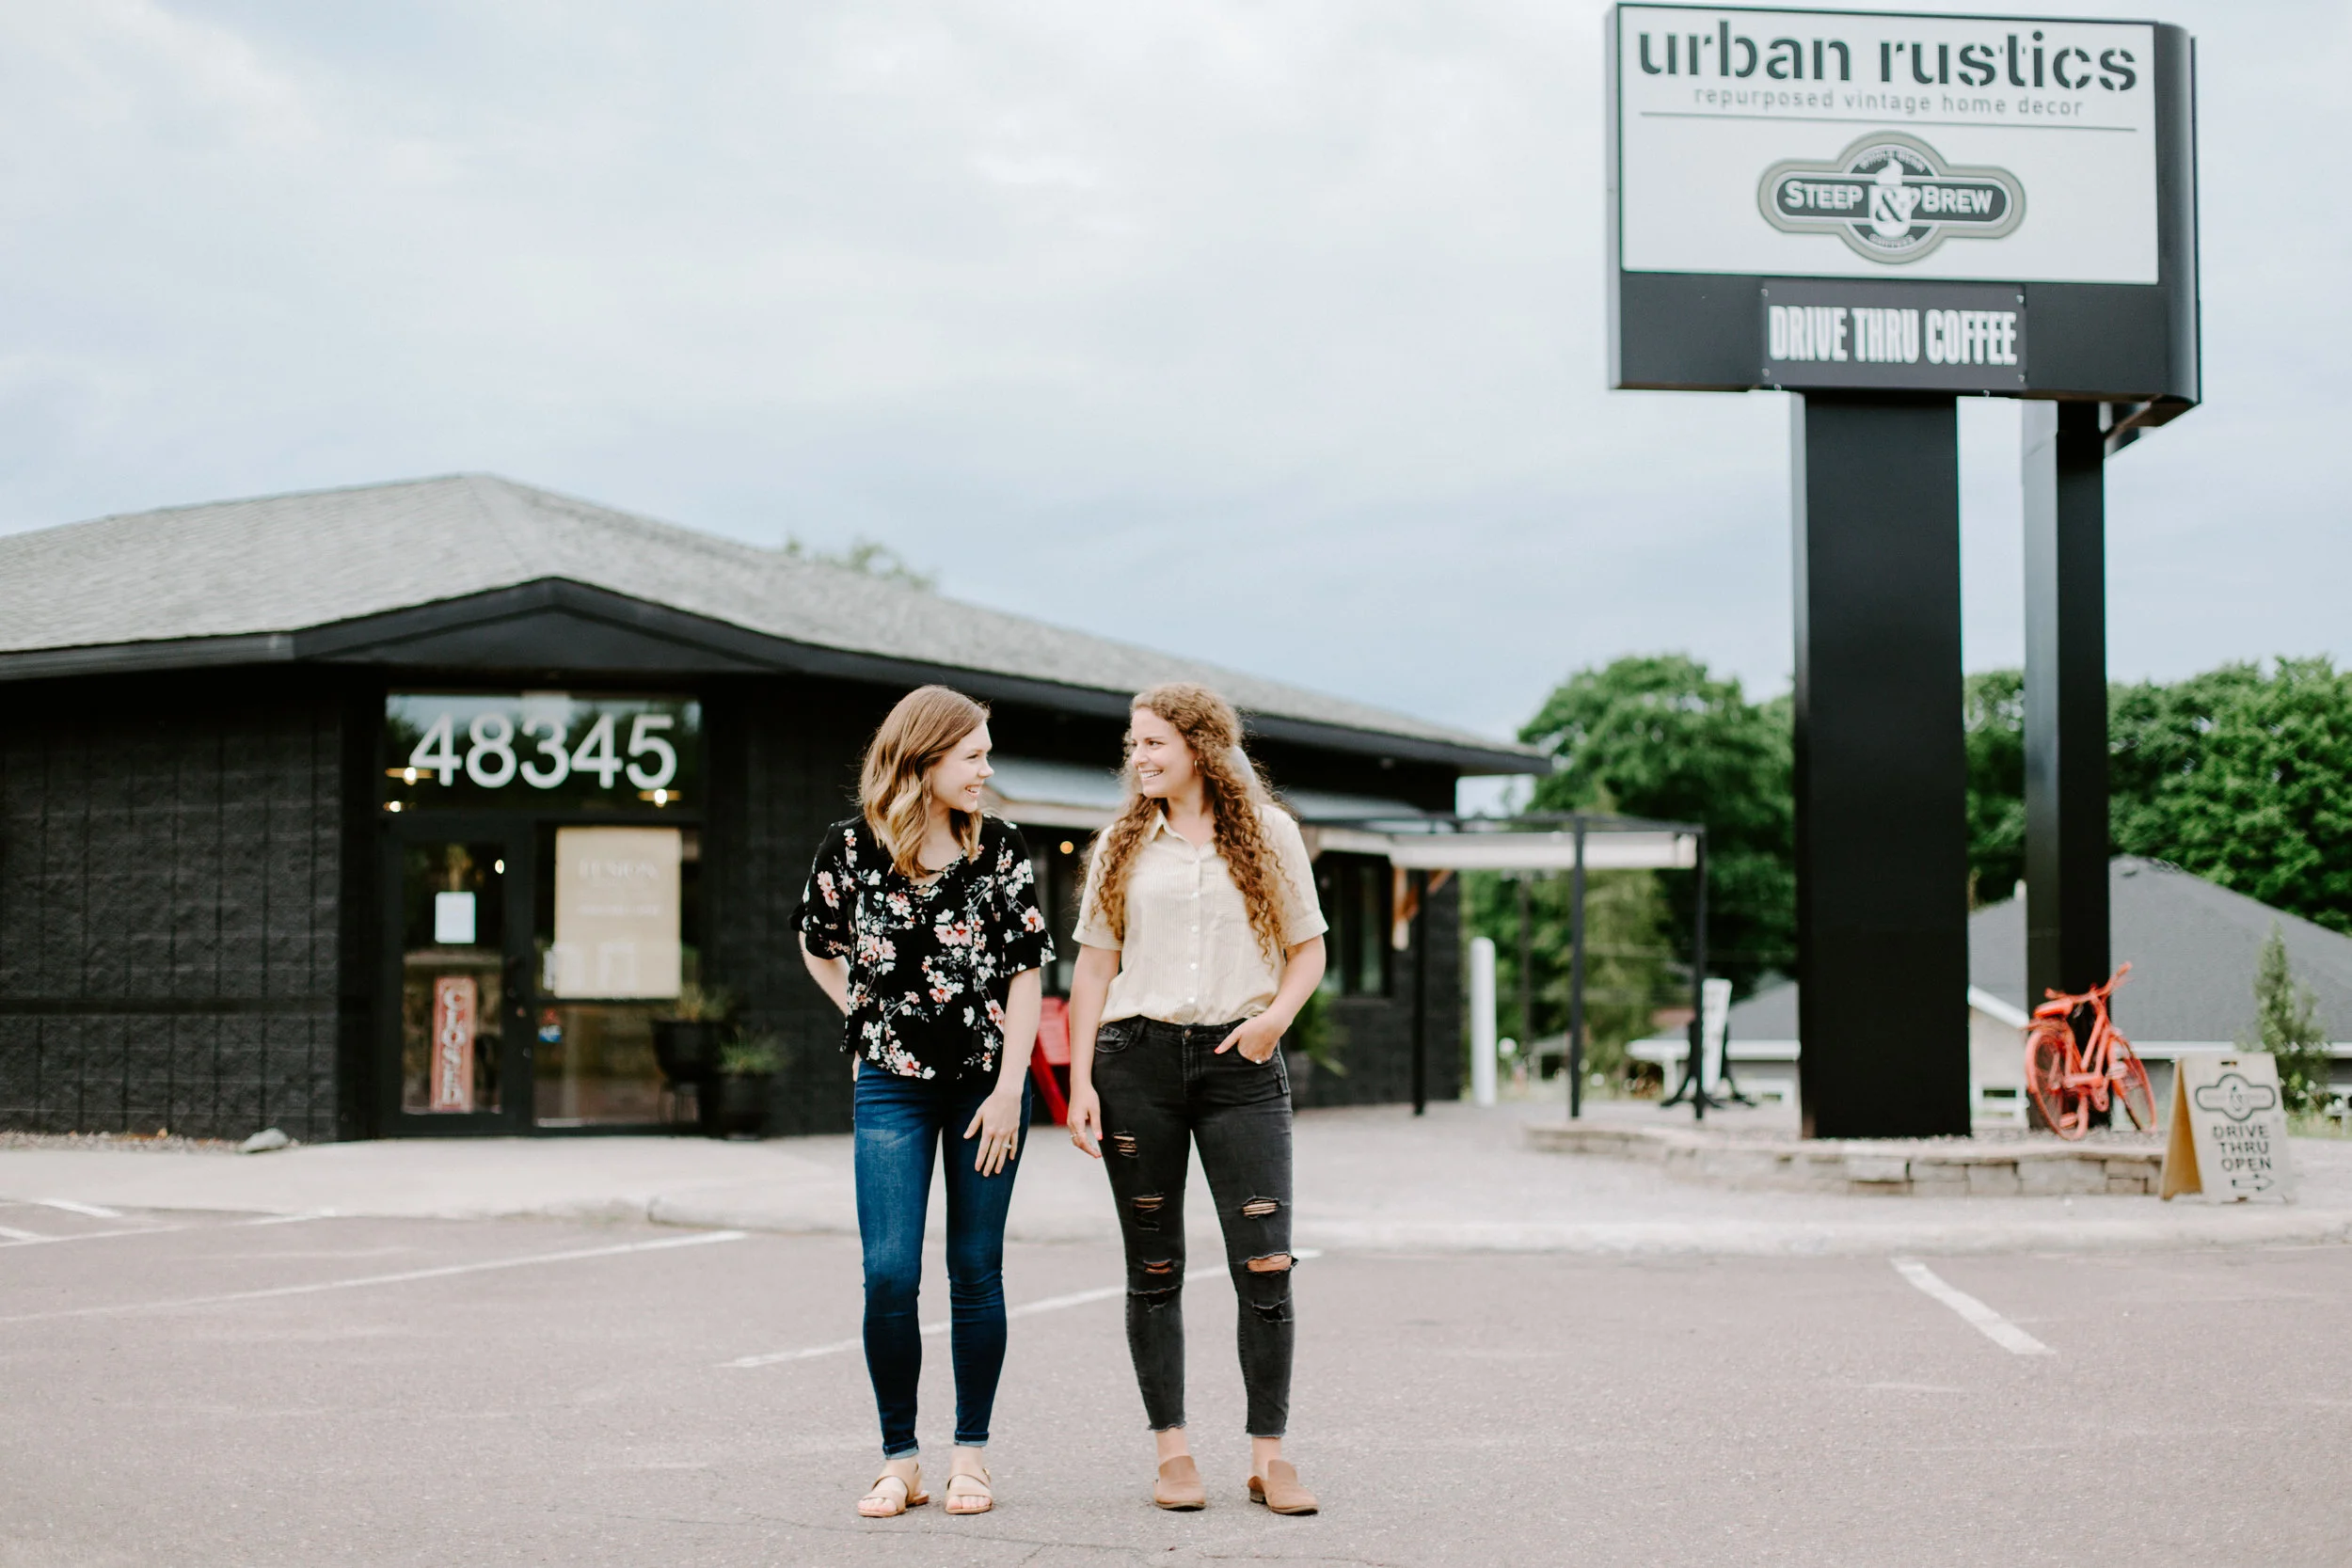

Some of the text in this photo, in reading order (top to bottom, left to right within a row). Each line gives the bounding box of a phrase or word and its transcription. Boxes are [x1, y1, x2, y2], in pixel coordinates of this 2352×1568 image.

[1640, 19, 2137, 91] urban rustics
[1694, 88, 2084, 115] repurposed vintage home decor
[1785, 181, 1994, 223] STEEP & BREW
[1769, 305, 2018, 366] DRIVE THRU COFFEE
[408, 712, 677, 789] 48345
[2213, 1125, 2270, 1139] DRIVE
[2218, 1141, 2269, 1154] THRU
[2221, 1157, 2271, 1172] OPEN
